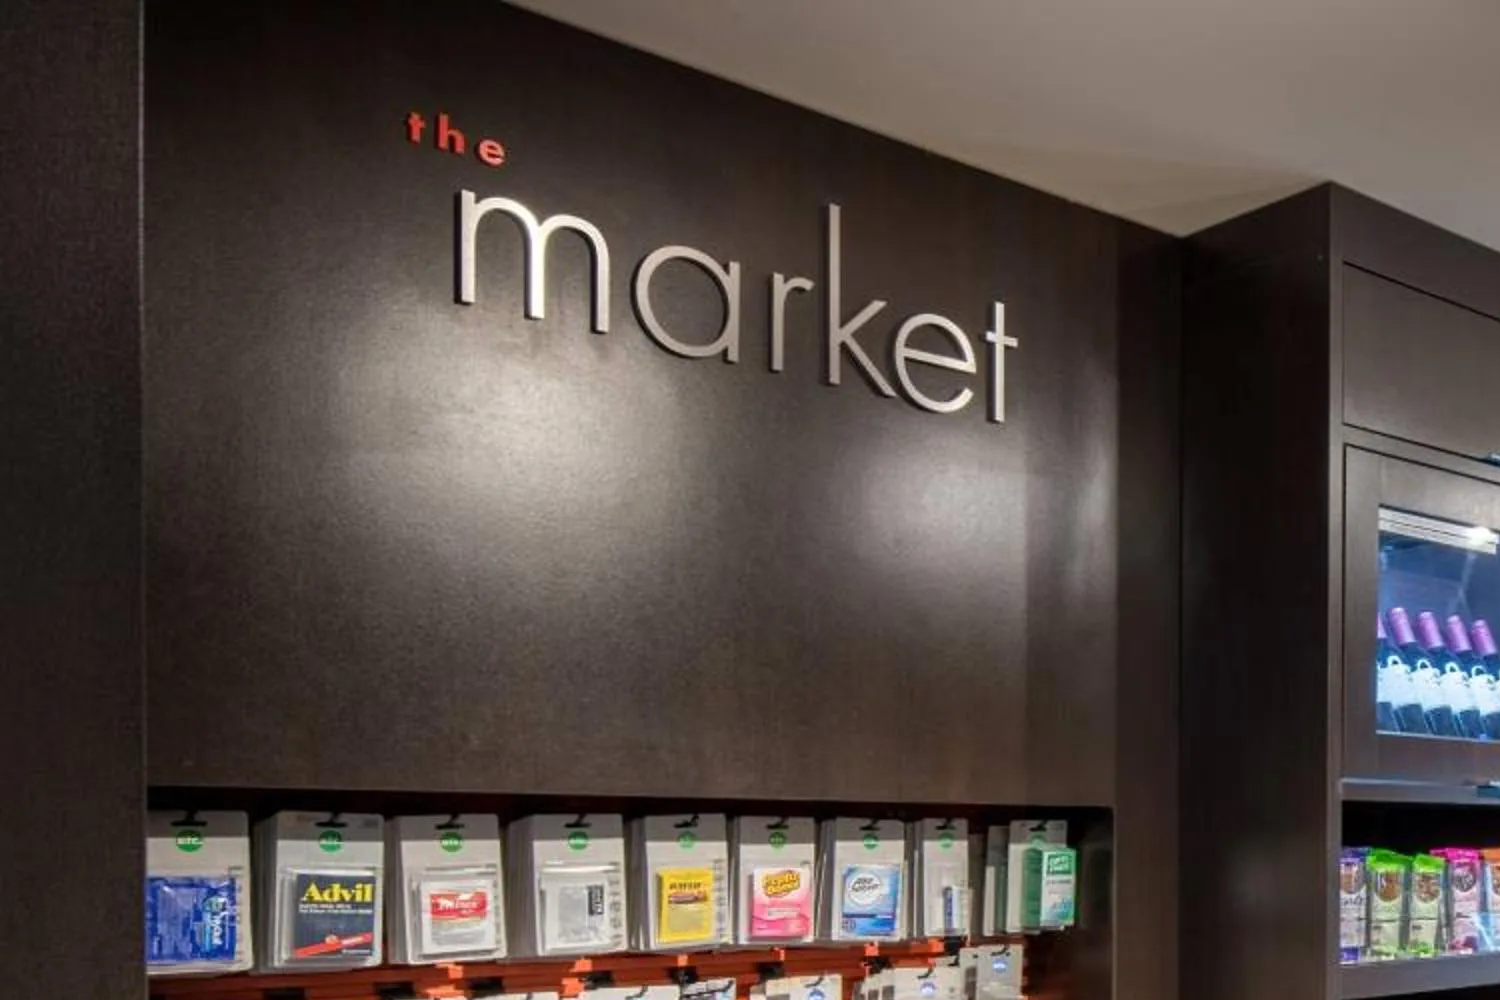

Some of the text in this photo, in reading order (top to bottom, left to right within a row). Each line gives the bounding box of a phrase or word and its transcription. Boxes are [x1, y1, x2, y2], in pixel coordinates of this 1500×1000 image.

[405, 111, 507, 165] the
[454, 188, 1019, 424] market
[302, 881, 373, 902] Advil
